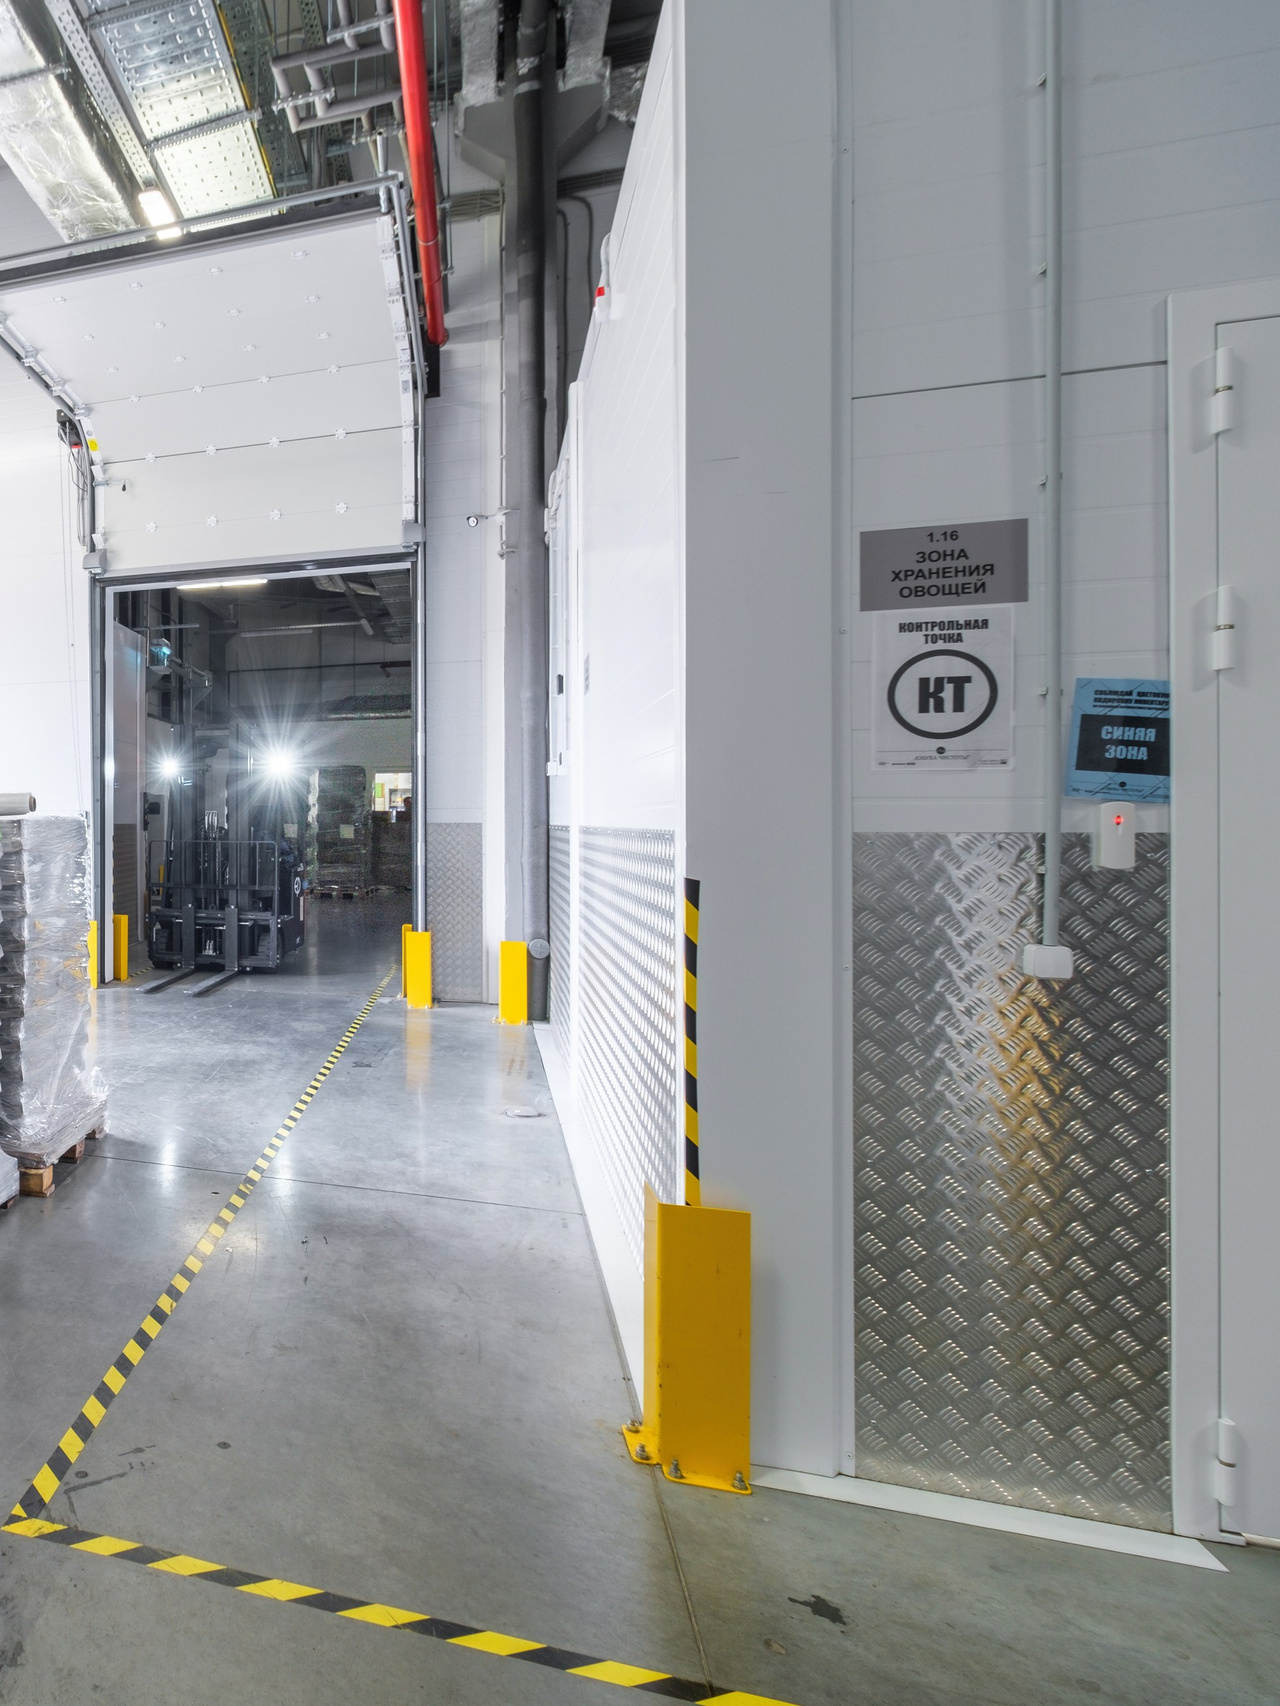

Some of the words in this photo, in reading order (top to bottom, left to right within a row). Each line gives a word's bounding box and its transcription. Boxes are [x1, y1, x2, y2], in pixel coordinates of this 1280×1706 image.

[927, 530, 959, 542] 1.16
[916, 548, 969, 563] ЗОНА
[891, 563, 994, 582] ХРАНЕНИЯ
[899, 578, 986, 598] ОВОЩЕЙ
[898, 618, 989, 633] КОНТРОЛЬНАЯ
[923, 632, 963, 644] ТОЧКА
[918, 676, 972, 714] КТ
[1101, 726, 1156, 742] СИНЯЯ
[1105, 745, 1148, 760] ЗОНА
